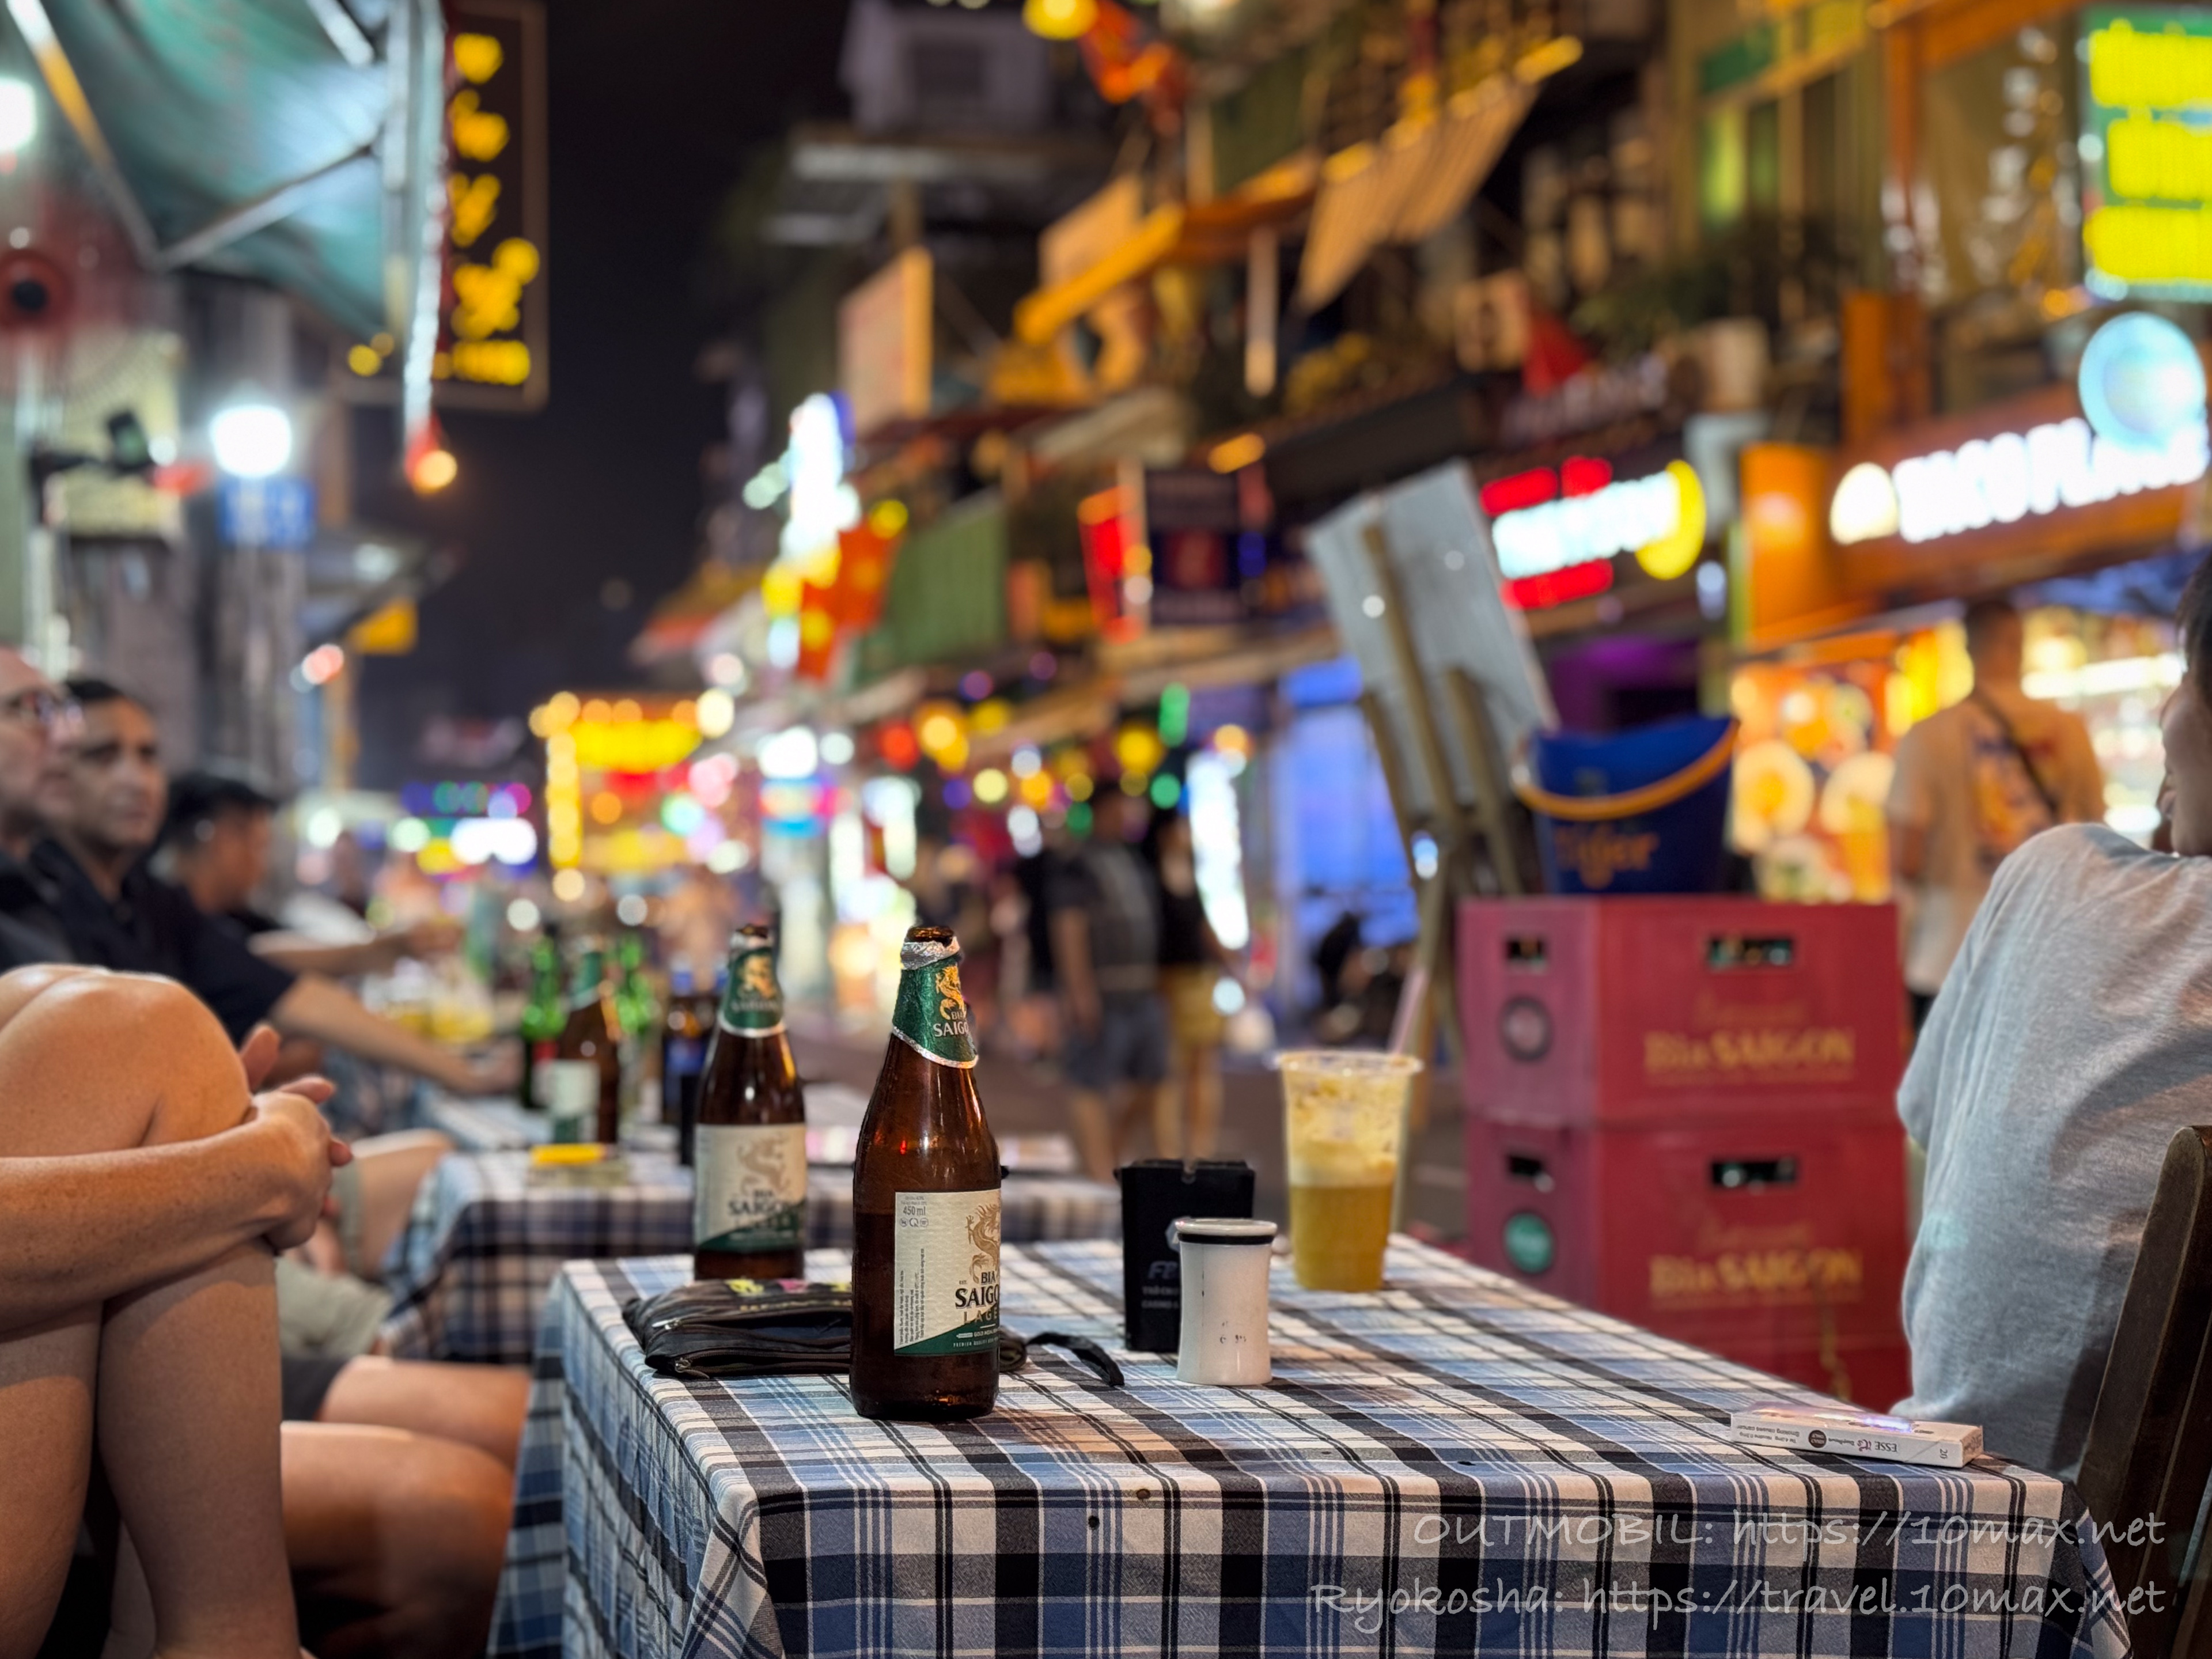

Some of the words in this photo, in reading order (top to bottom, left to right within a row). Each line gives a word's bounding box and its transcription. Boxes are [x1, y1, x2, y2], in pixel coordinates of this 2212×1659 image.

[1711, 1028, 1854, 1069] SAIGON
[903, 1206, 916, 1215] 450
[916, 1206, 926, 1216] ml
[1717, 1249, 1862, 1291] SAIGON
[981, 1271, 996, 1284] BIA
[1777, 1429, 1800, 1437] Smoking
[1875, 1441, 1897, 1452] ESSE
[1940, 1449, 1948, 1459] 20
